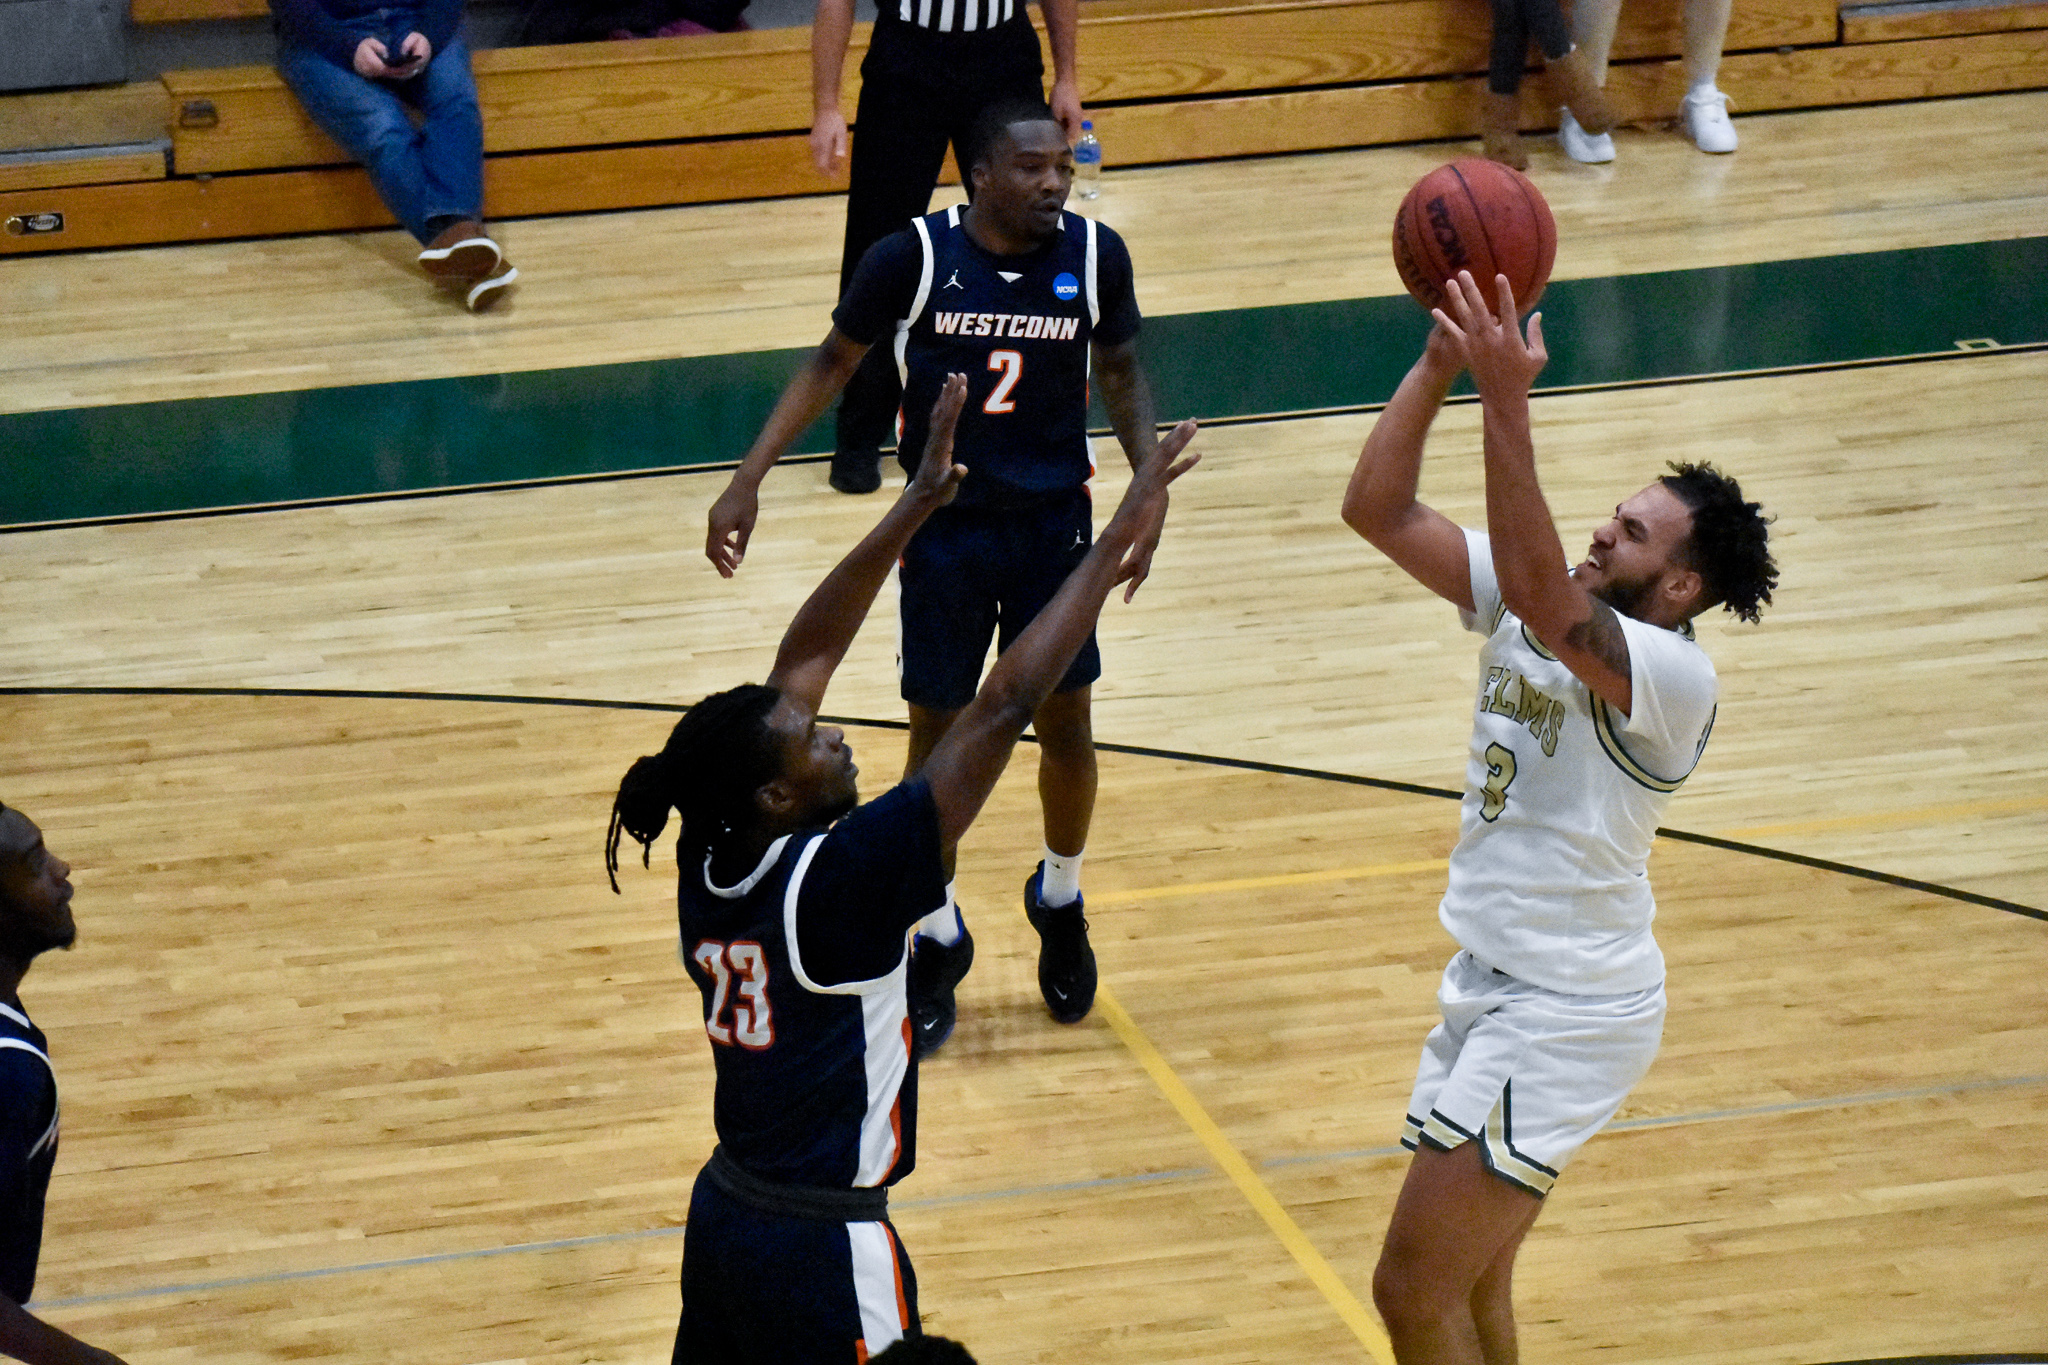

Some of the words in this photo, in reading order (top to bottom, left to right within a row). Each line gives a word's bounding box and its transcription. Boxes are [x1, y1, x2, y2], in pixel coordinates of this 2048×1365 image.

[935, 311, 1080, 341] WESTCONN
[1056, 285, 1078, 294] NCAA
[982, 348, 1024, 415] 2
[1480, 666, 1566, 758] ELMS
[1479, 741, 1518, 823] 3
[693, 938, 776, 1052] 23
